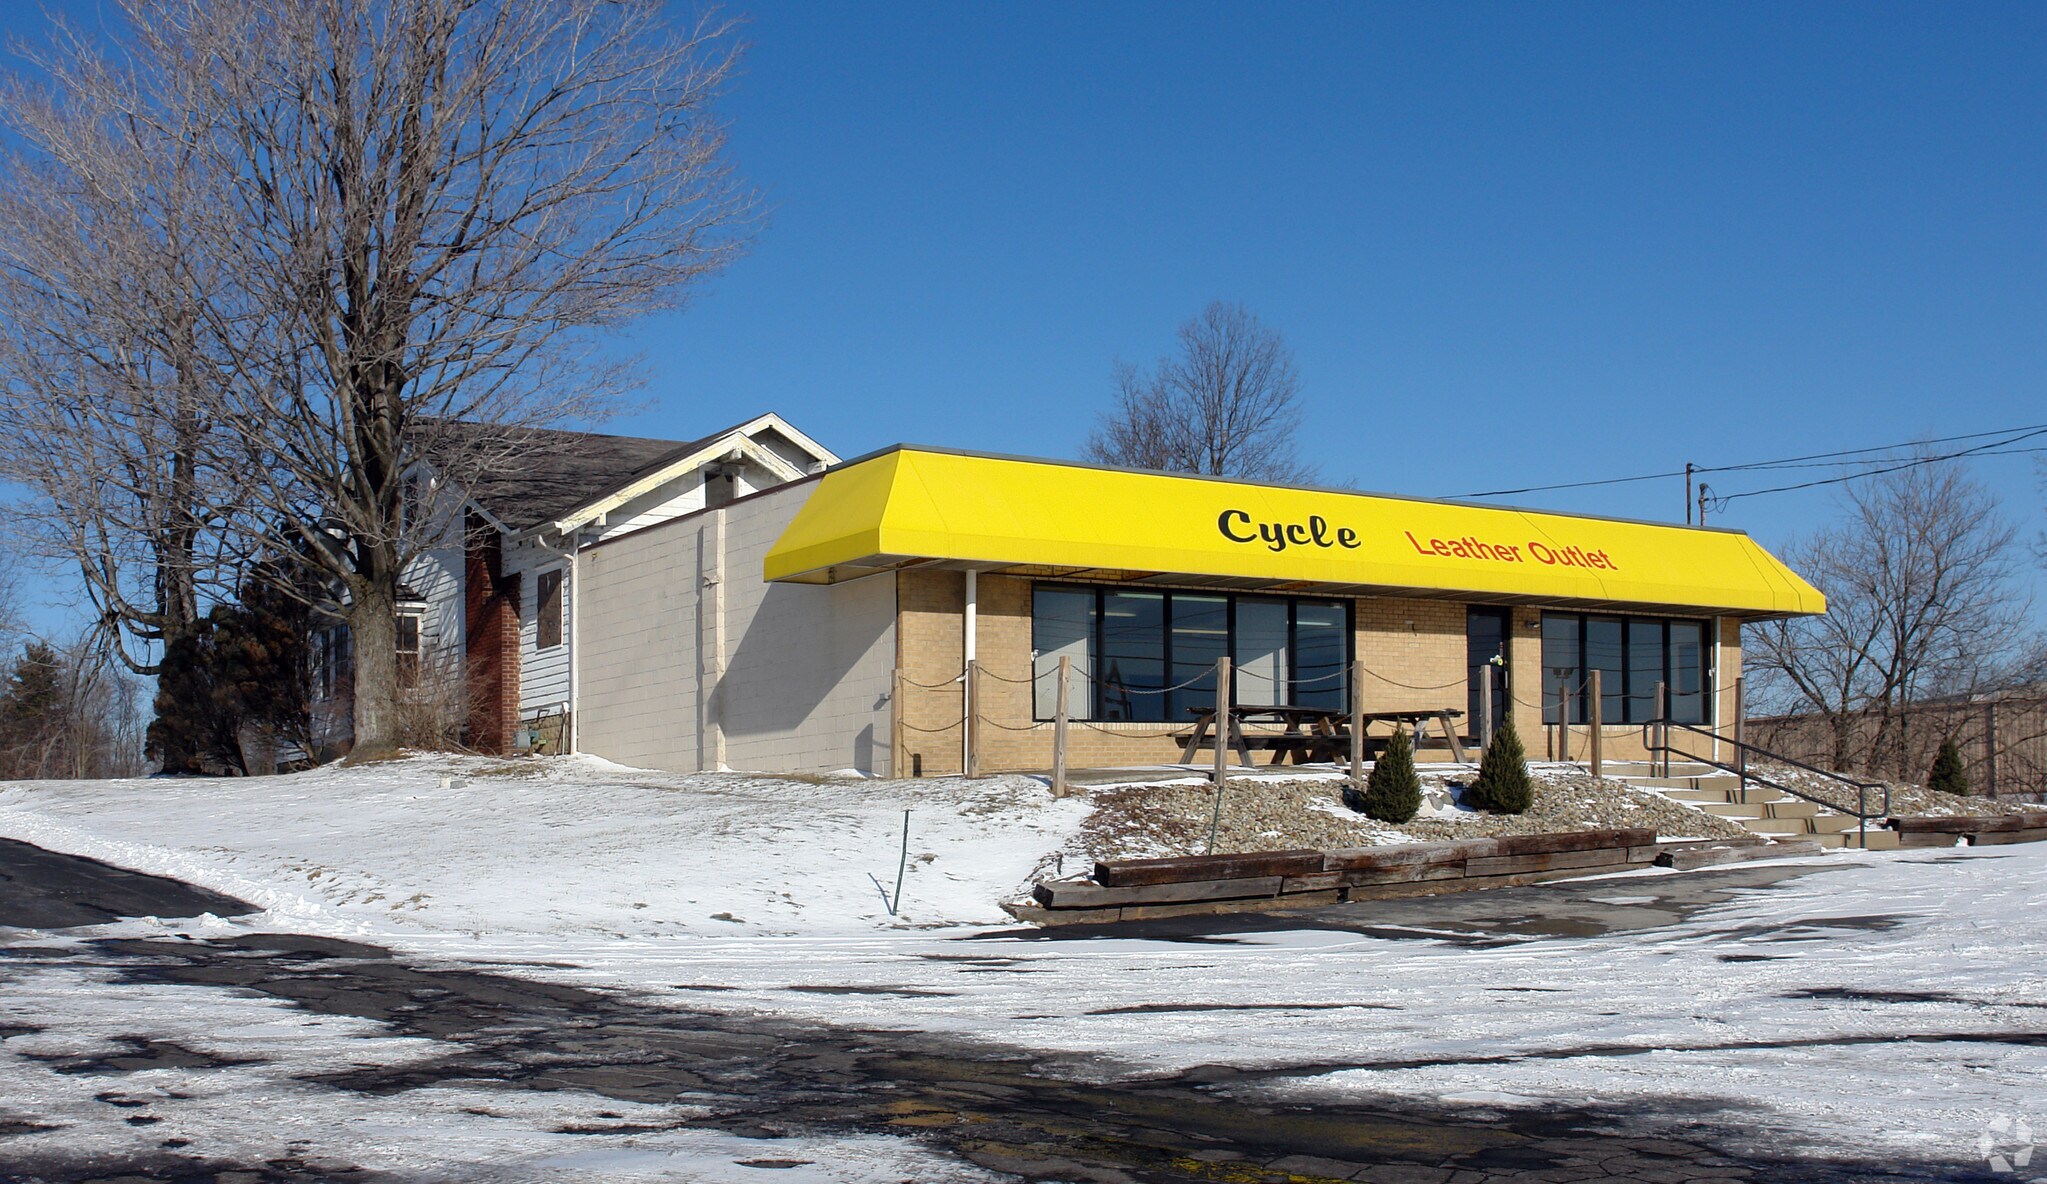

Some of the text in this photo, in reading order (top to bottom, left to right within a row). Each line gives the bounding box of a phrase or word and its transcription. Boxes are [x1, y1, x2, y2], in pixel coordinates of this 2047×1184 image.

[1218, 509, 1618, 571] Cycle Leather Outlet
